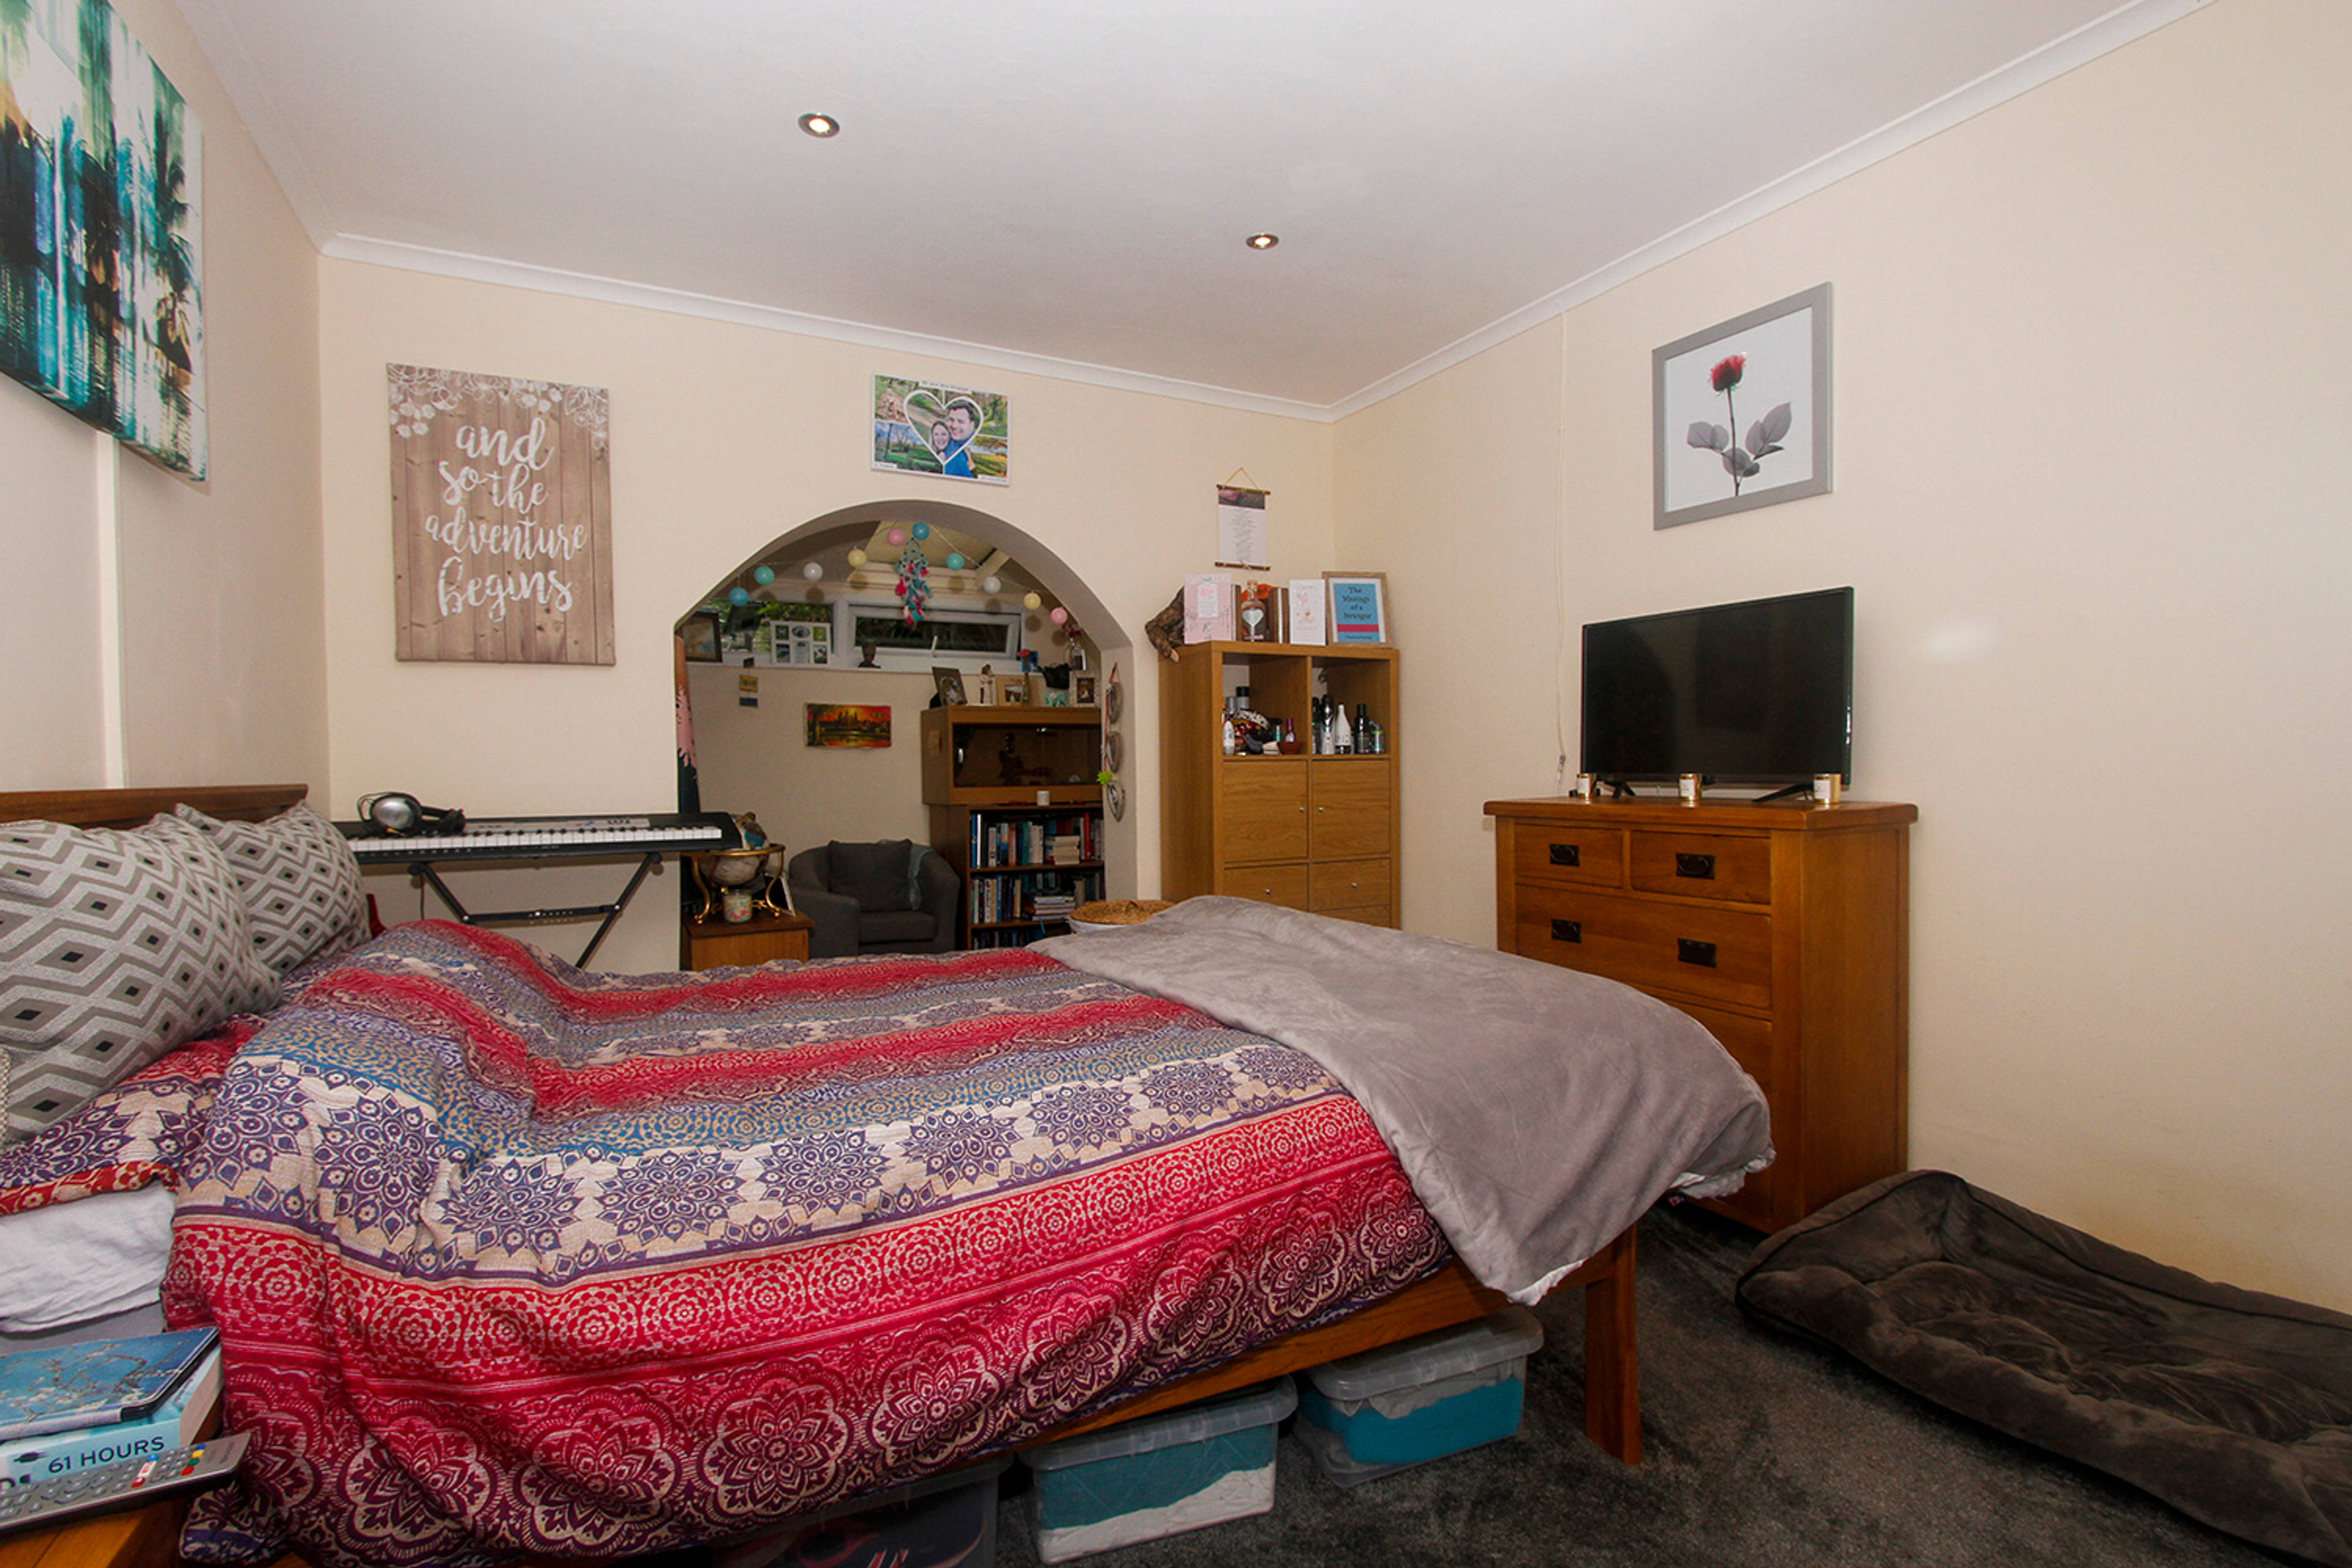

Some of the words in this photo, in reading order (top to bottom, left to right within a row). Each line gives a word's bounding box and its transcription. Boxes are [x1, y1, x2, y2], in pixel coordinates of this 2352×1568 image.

[456, 417, 555, 470] and
[439, 461, 489, 506] so
[484, 463, 549, 514] the
[424, 507, 588, 560] adventure
[438, 556, 575, 623] begins
[48, 1455, 72, 1474] 61
[80, 1435, 165, 1467] HOURS
